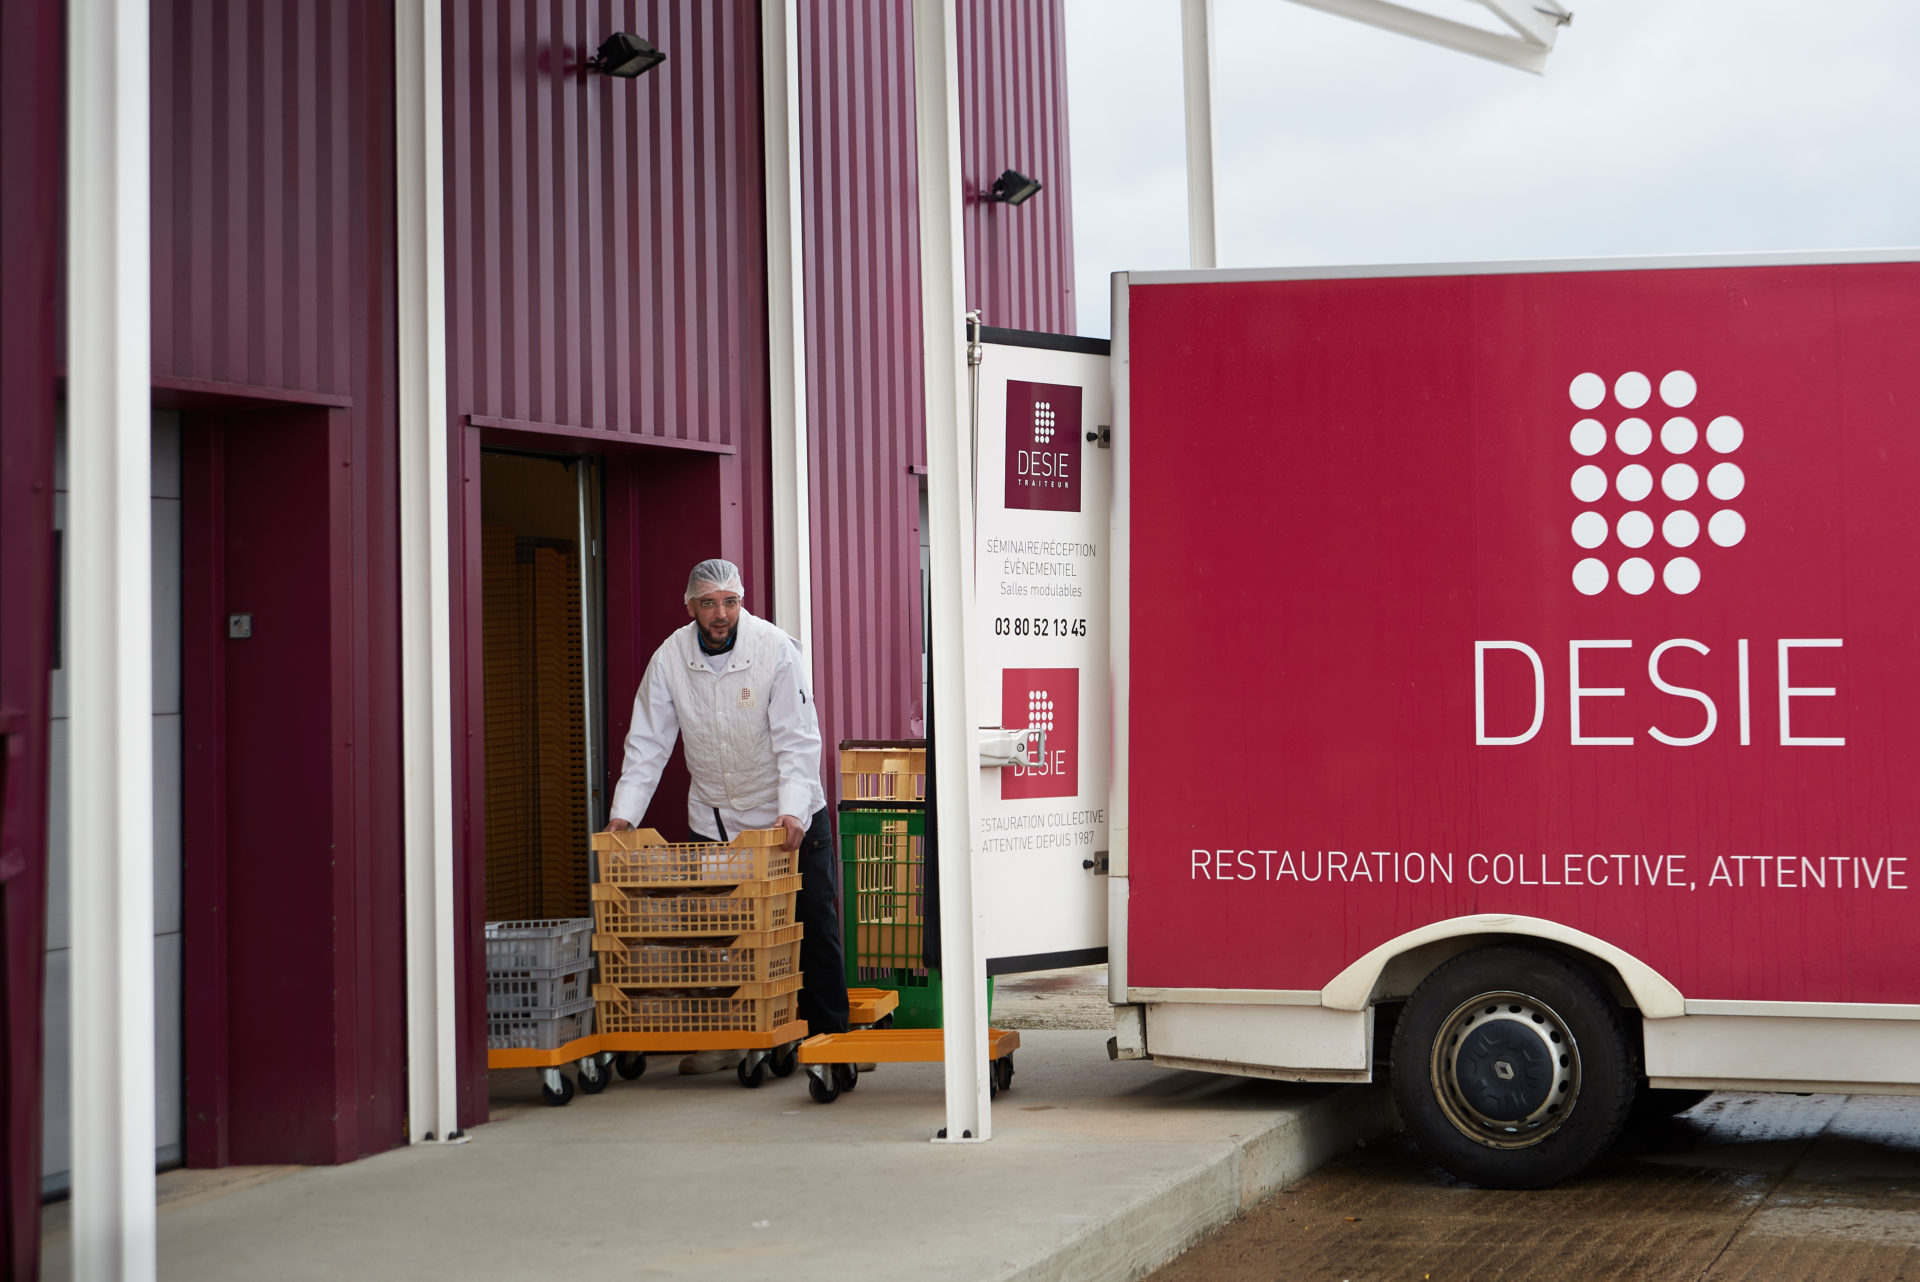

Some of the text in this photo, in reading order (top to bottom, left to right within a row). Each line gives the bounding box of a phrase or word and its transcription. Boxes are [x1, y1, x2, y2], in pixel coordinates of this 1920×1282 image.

[1018, 450, 1069, 478] DESIE
[1018, 478, 1069, 488] TRAITEUR
[986, 536, 1097, 557] SÉMINAIRE/RÉCEPTION
[1000, 581, 1083, 598] Salles modulables
[995, 617, 1087, 637] 03 80 52 13 45
[1475, 638, 1845, 747] DESIE
[1047, 809, 1105, 828] COLLECTIVE
[982, 831, 1095, 854] ATTENTIVE DEPUIS 1987
[1190, 849, 1909, 892] RESTAURATION COLLECTIVE, ATTENTIVE
